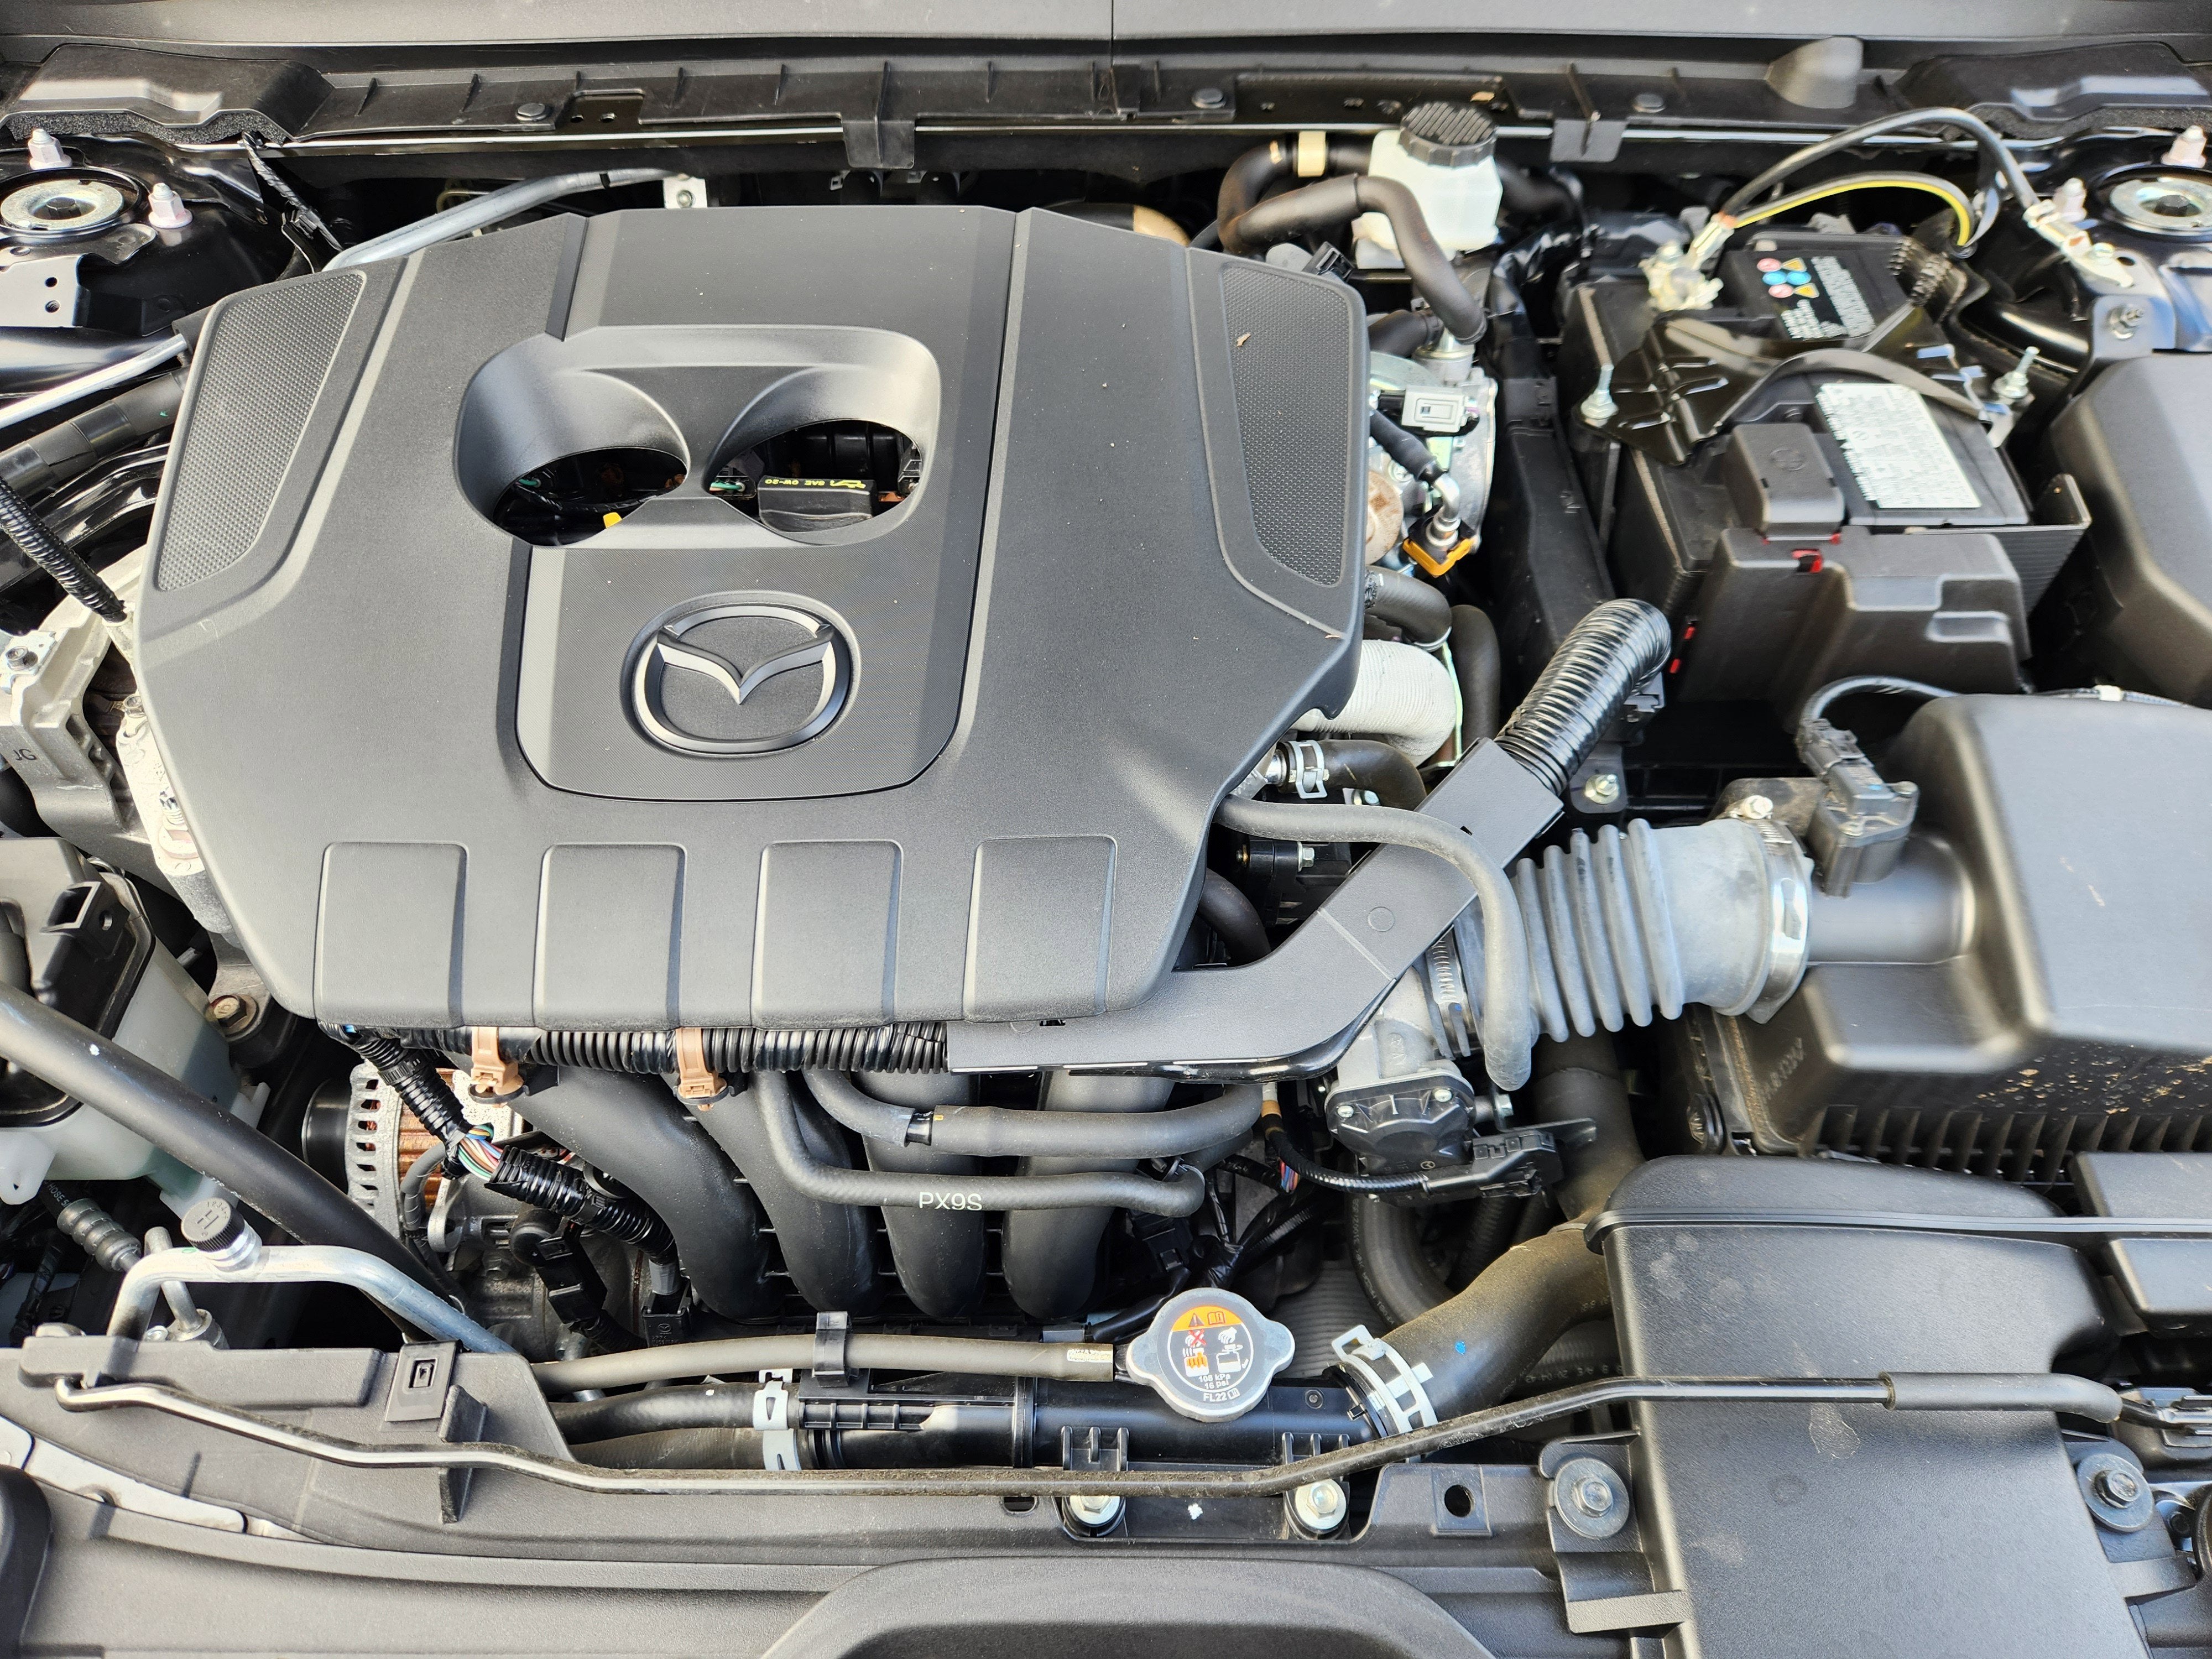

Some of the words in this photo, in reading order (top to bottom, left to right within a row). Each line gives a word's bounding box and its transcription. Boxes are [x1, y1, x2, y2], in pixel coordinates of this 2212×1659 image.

[48, 1183, 65, 1202] HOSE
[919, 1191, 983, 1211] PX9S
[1198, 1374, 1213, 1383] 108
[1215, 1379, 1229, 1389] psi
[1203, 1392, 1228, 1402] FL22
